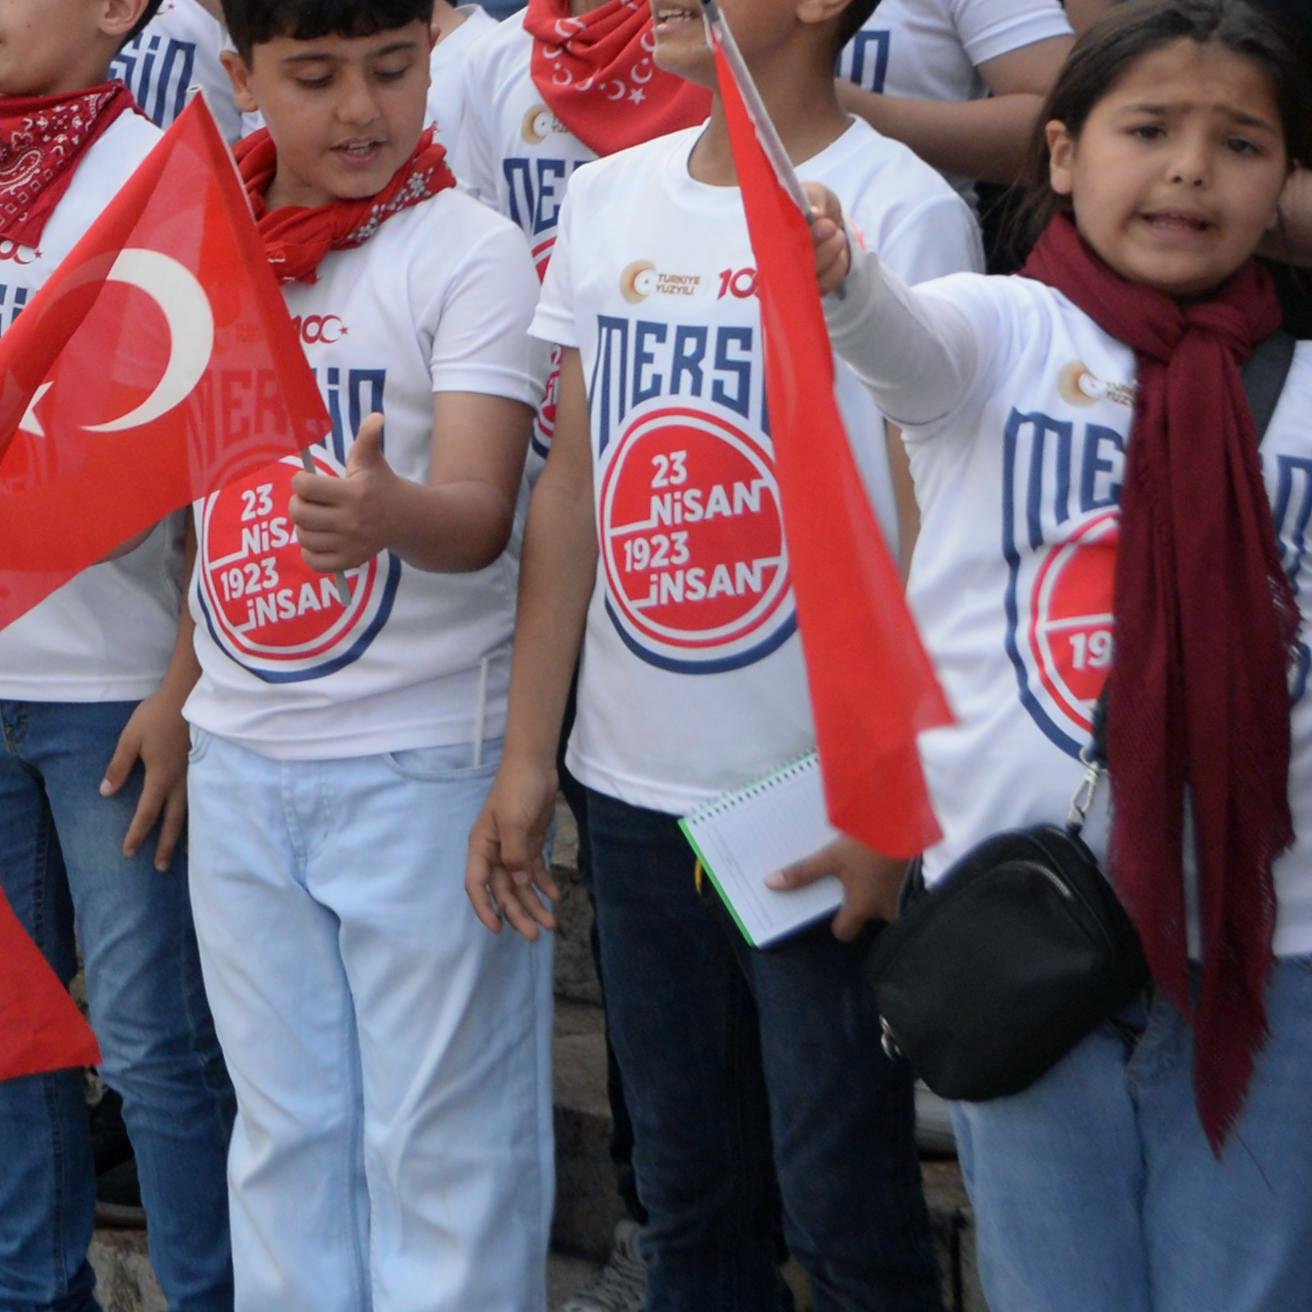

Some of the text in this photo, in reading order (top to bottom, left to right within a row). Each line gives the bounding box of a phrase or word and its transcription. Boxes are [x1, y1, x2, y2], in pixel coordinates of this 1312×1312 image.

[651, 450, 688, 488] 23
[241, 484, 273, 521] 23
[241, 516, 299, 556] NiS
[623, 531, 690, 572] 1923
[221, 556, 280, 602] 1923
[1069, 630, 1113, 670] 19
